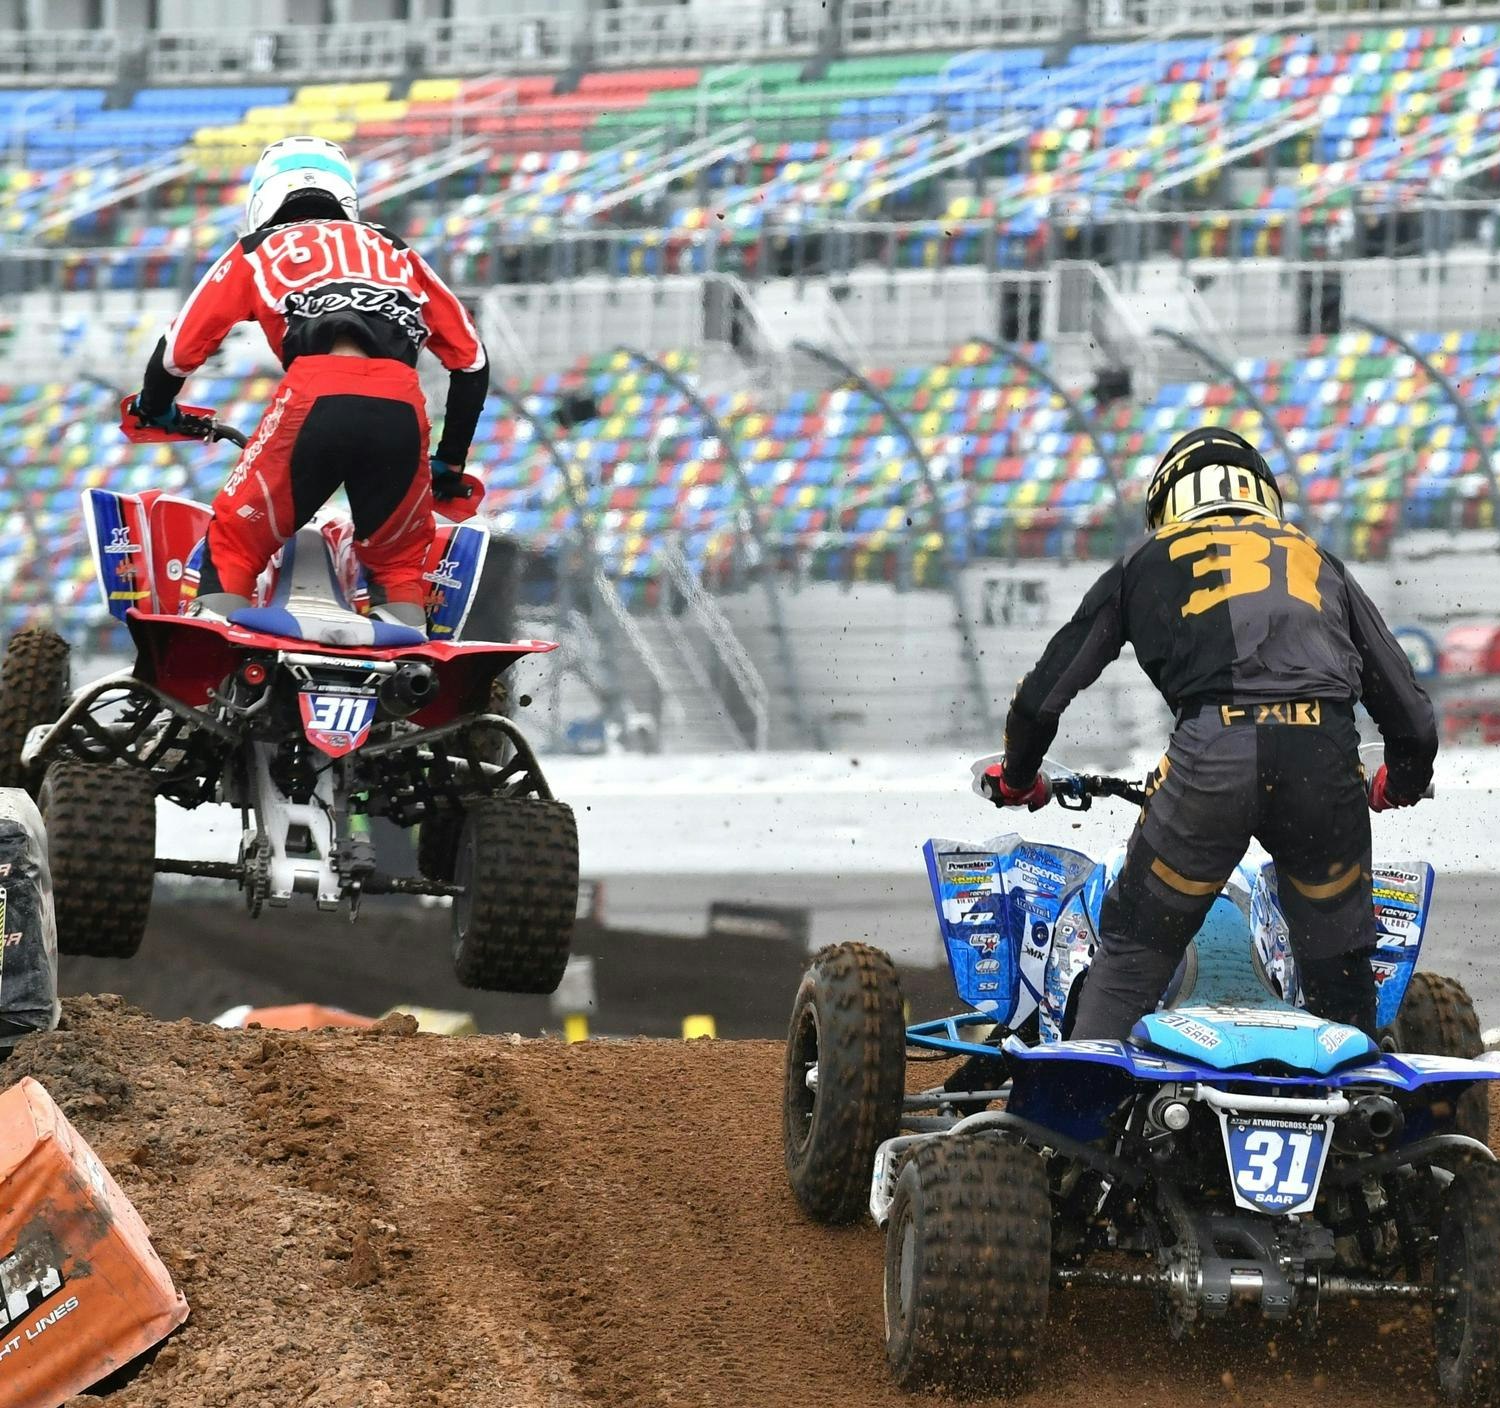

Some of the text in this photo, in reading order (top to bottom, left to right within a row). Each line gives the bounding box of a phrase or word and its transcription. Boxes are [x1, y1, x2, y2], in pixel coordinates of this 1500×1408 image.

[1168, 530, 1323, 619] 31
[307, 696, 369, 732] 311
[1252, 1118, 1324, 1131] ATVMOTOCROSS.COM
[1236, 1130, 1313, 1195] 31
[1255, 1193, 1294, 1205] SAAR
[25, 1296, 80, 1341] LINES
